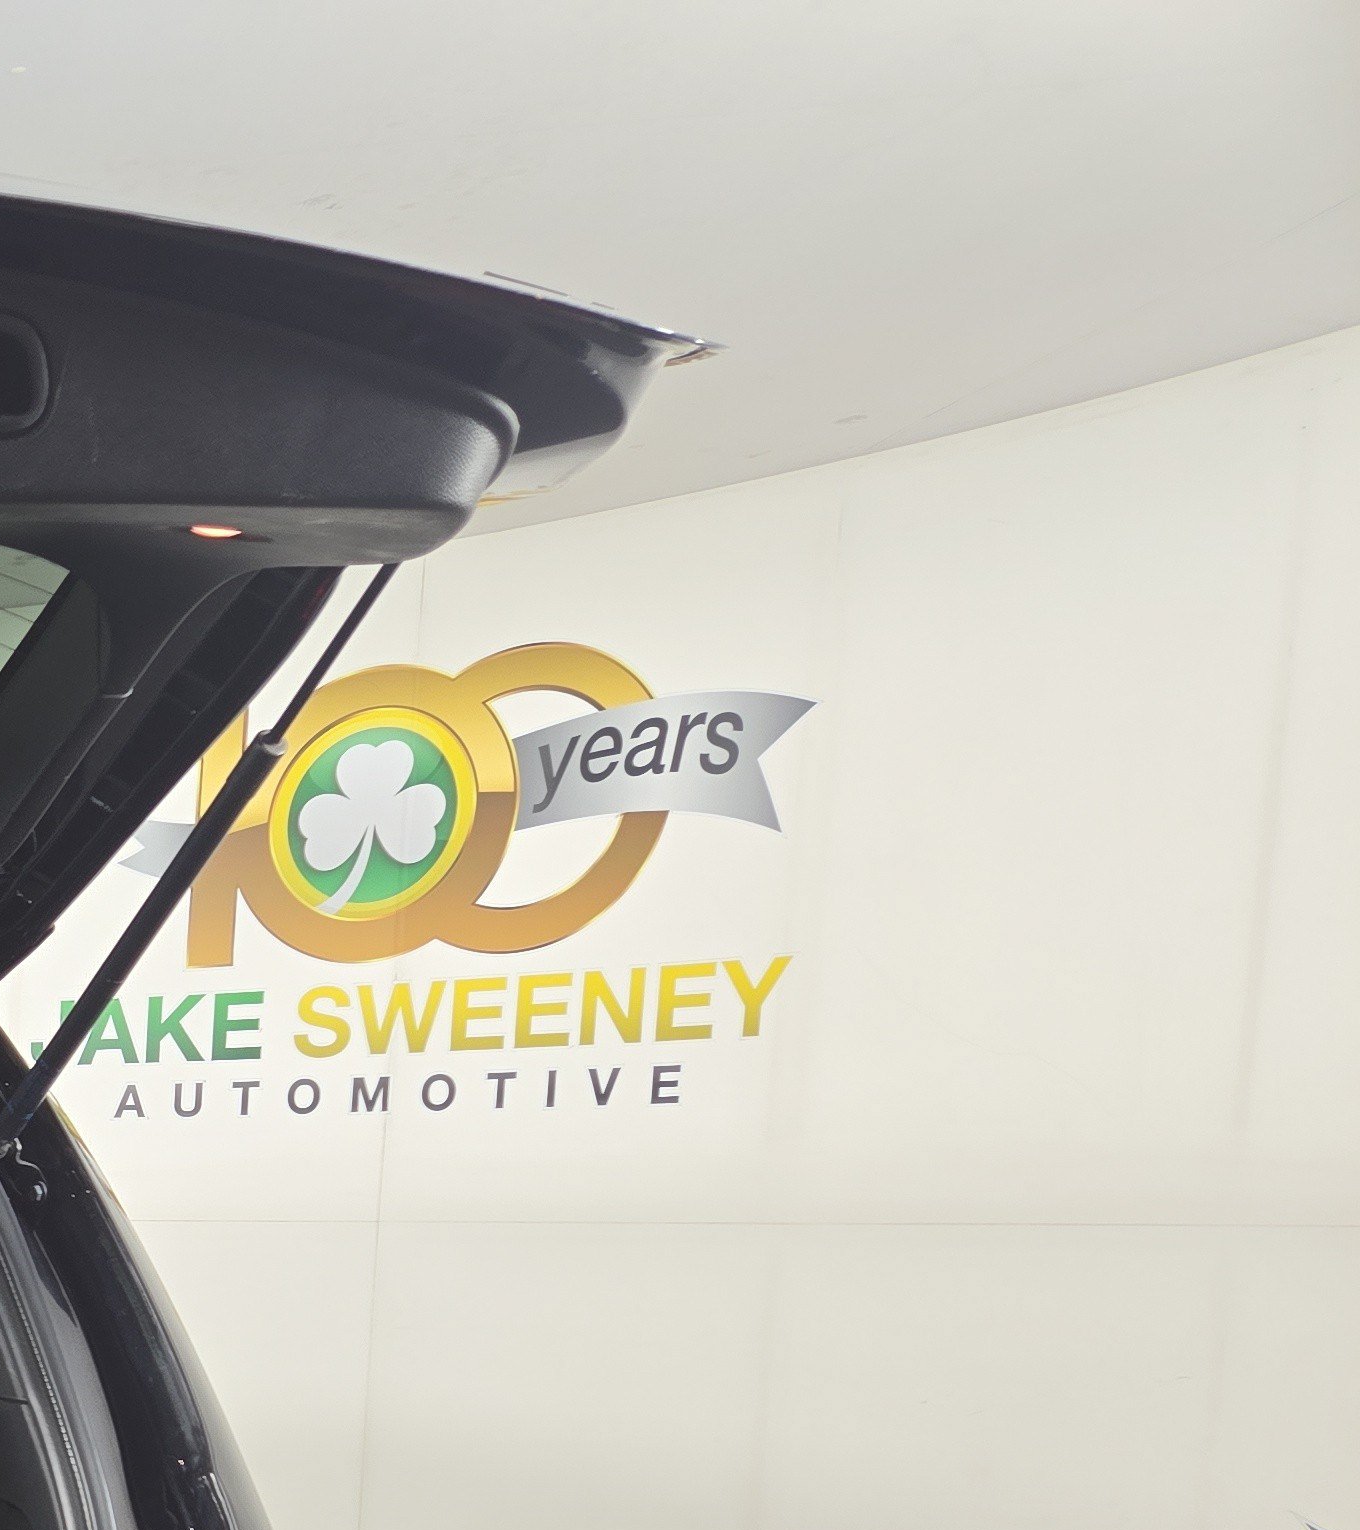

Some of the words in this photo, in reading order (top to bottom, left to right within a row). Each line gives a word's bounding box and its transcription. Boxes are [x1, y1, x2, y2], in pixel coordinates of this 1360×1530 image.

[186, 641, 671, 969] 100
[532, 709, 745, 814] years
[293, 955, 793, 1059] SWEENEY
[114, 1064, 683, 1120] AUTOMOTIVE
